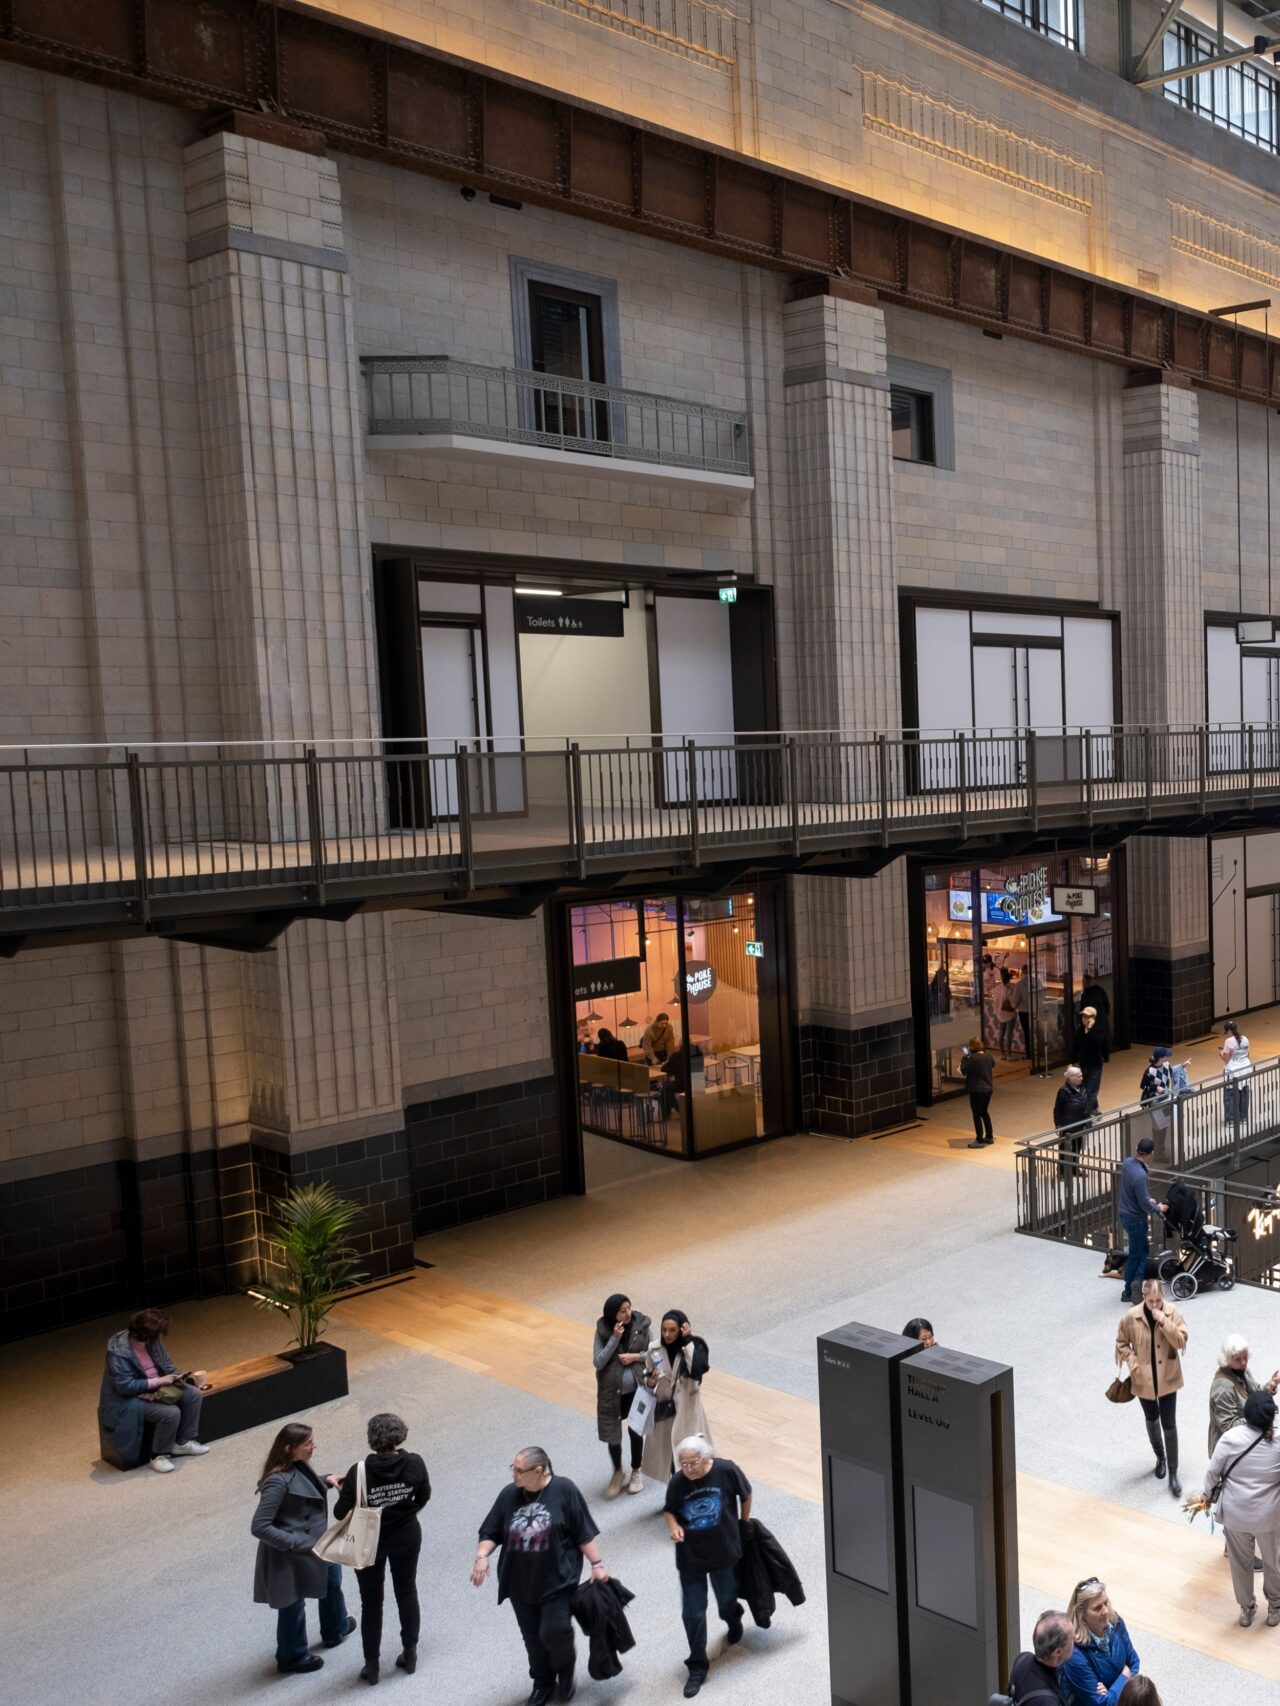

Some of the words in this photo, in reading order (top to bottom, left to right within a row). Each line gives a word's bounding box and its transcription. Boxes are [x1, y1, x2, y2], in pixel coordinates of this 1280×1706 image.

[527, 616, 555, 628] Toilets
[1020, 867, 1048, 893] POKE
[1005, 888, 1048, 921] HOUSE
[694, 967, 712, 982] POKE
[687, 978, 712, 996] HOUSE
[907, 1386, 930, 1401] HALL
[908, 1408, 934, 1424] LEVEL
[367, 1491, 386, 1500] OWER
[387, 1486, 414, 1497] STATION
[371, 1482, 406, 1494] BATTERSEA
[370, 1493, 409, 1506] COMMUNITY
